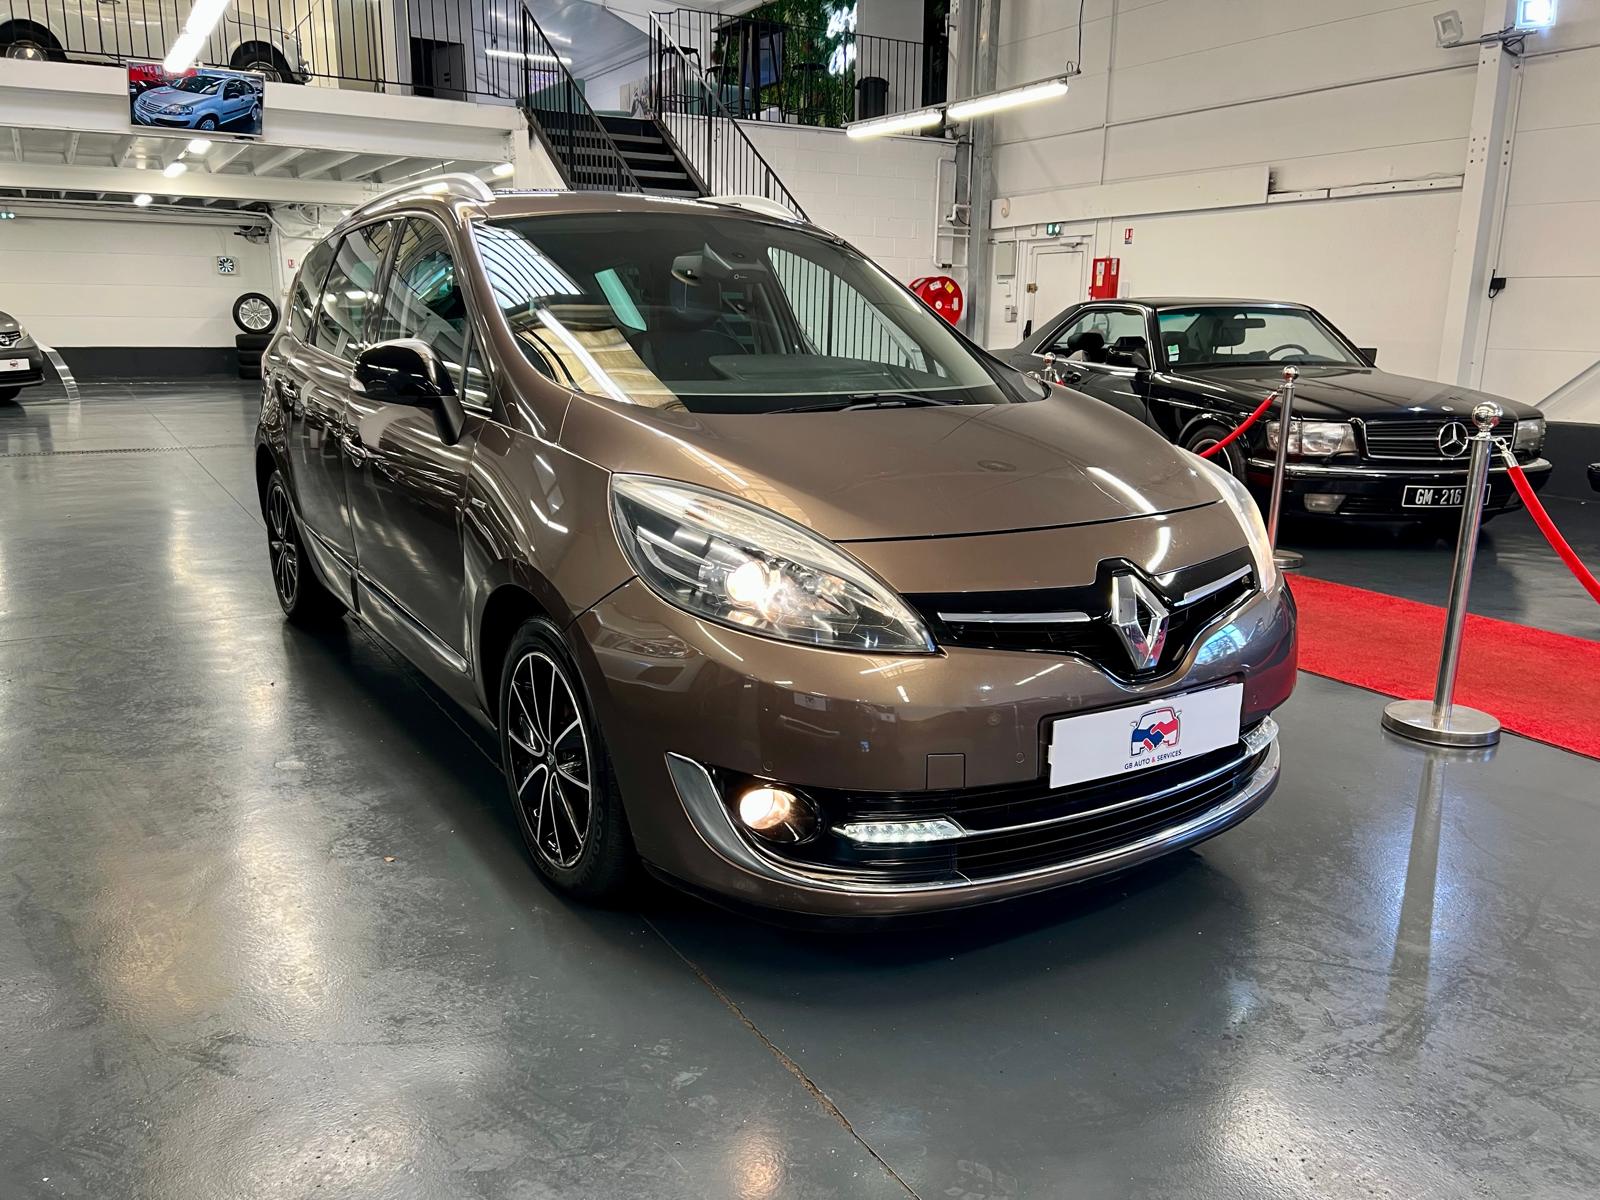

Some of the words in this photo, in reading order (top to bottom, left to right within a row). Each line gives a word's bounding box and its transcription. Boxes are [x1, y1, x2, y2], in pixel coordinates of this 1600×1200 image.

[1133, 758, 1150, 768] AUTO
[1151, 756, 1157, 764] &
[1156, 748, 1182, 762] SERVICES
